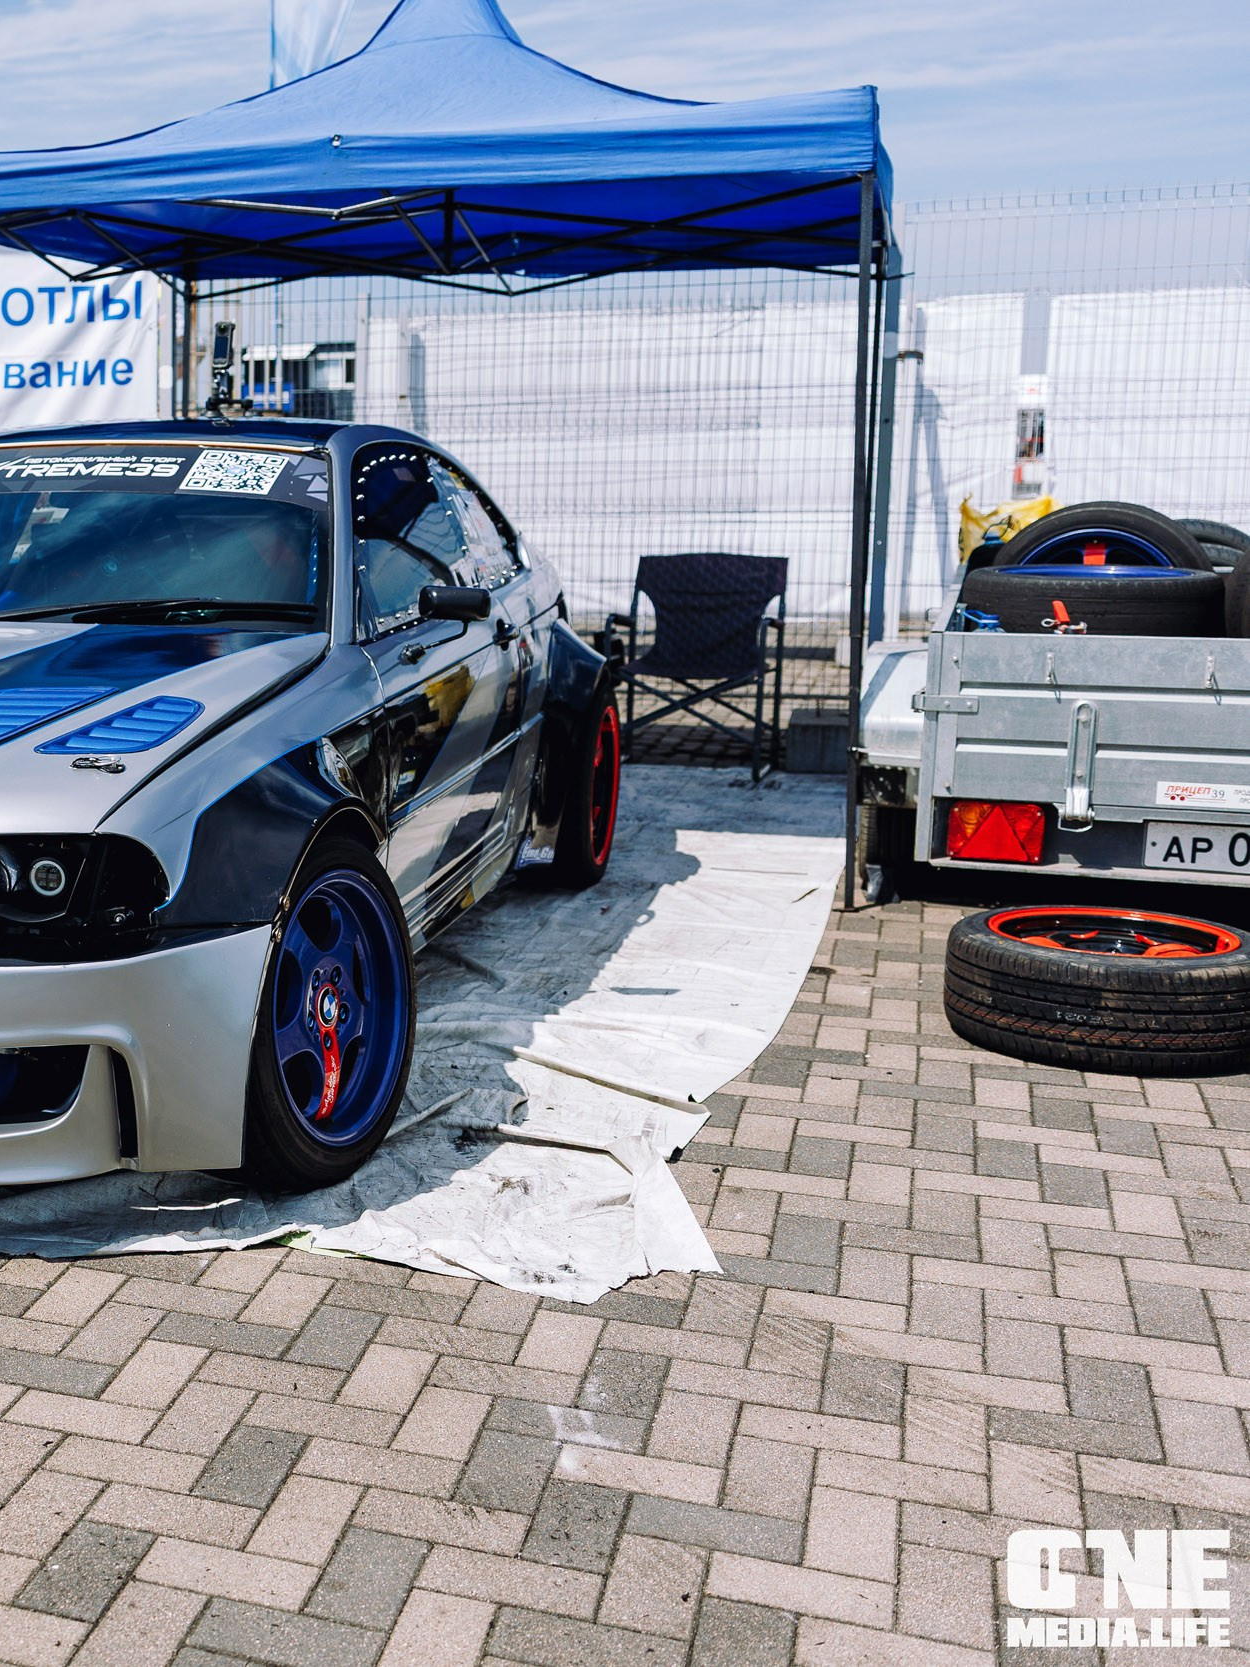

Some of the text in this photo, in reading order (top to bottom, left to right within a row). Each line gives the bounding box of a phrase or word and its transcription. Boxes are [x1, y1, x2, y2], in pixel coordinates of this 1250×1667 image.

[140, 456, 186, 464] СПОРТ
[1166, 785, 1225, 799] ПРИЦЕП 39
